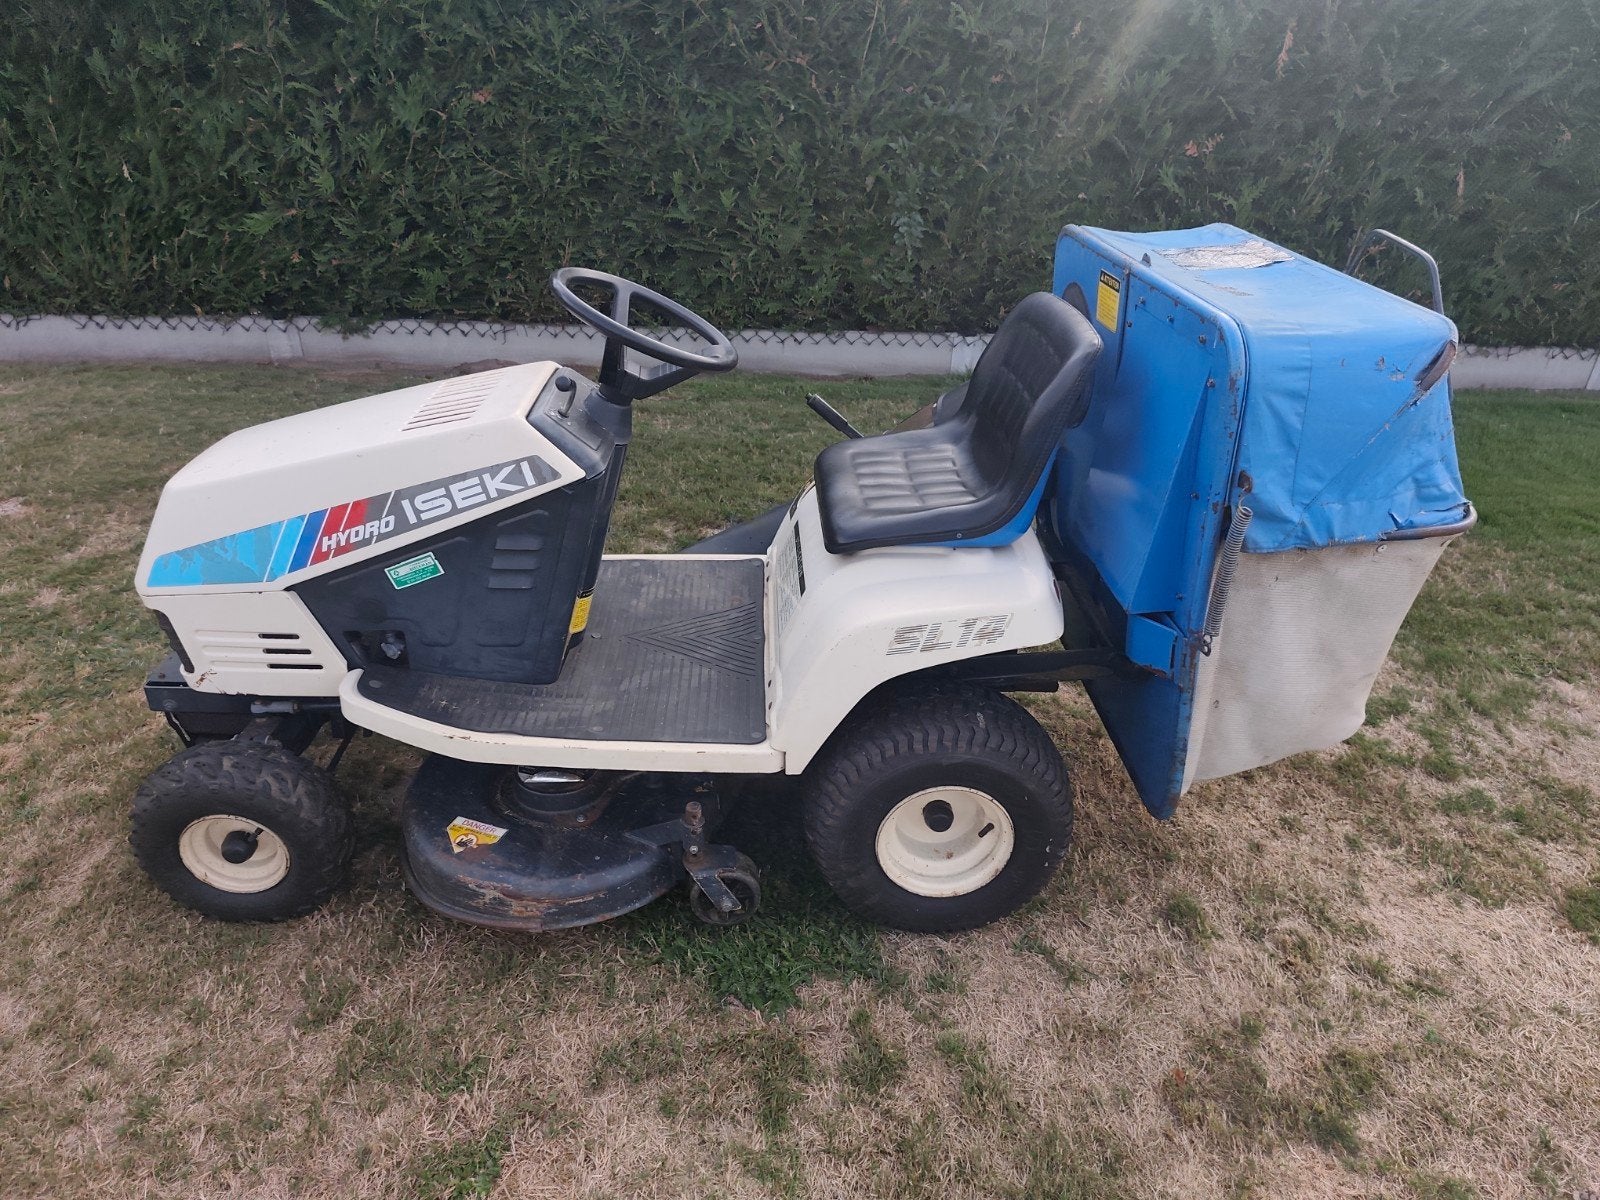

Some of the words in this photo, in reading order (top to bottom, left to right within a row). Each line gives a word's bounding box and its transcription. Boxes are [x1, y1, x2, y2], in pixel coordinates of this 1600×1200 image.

[401, 460, 536, 525] ISEKI
[321, 515, 395, 552] HYDRO
[462, 819, 497, 834] DANGER
